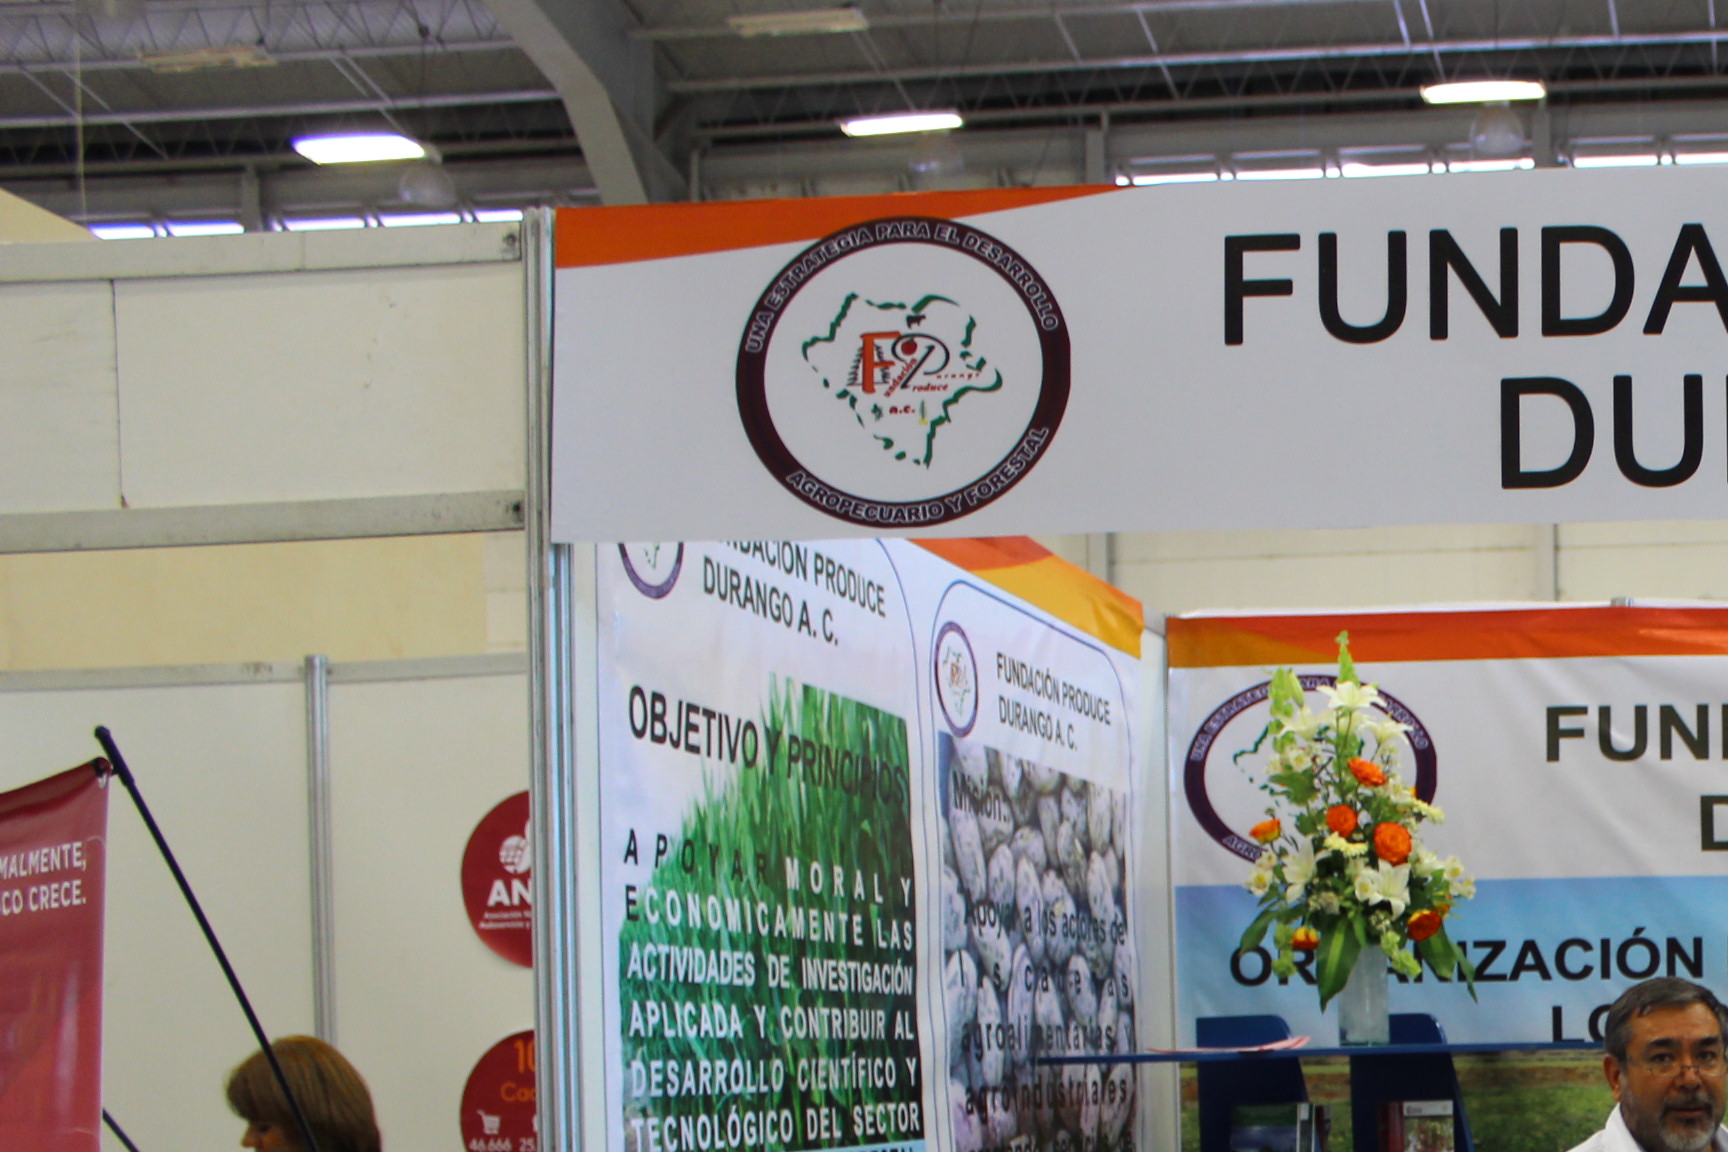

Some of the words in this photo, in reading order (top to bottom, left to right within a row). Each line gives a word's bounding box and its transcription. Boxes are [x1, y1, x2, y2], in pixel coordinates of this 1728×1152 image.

[746, 314, 772, 353] UNA
[772, 226, 873, 311] ESTRATEGIA
[876, 221, 930, 240] PARA
[935, 224, 960, 244] EL
[963, 232, 1058, 331] DESARROLLO
[787, 471, 944, 523] AGROPECUARIO
[945, 491, 964, 513] Y
[967, 426, 1049, 500] FORESTAL
[703, 555, 794, 628] DURANGO
[798, 601, 818, 639] A.
[821, 609, 838, 647] C.
[814, 551, 887, 618] PRODUCE
[997, 652, 1061, 705] FUNDACIÓN
[1062, 680, 1111, 726] PRODUCE
[999, 695, 1053, 744] DURANGO
[629, 684, 759, 770] OBJETIVO
[764, 726, 783, 776] Y
[787, 734, 909, 806] PRINCIPIOS
[29, 879, 86, 912] CRECE.
[623, 828, 768, 887] APOYAR
[785, 856, 884, 904] MORAL
[900, 876, 912, 908] Y
[625, 884, 864, 946] ECONOMICAMENTE
[876, 918, 913, 951] LAS
[1024, 906, 1032, 933] a
[1062, 911, 1106, 945] actores
[627, 941, 756, 989] ACTIVIDADES
[767, 954, 791, 990] DE
[801, 956, 914, 996] INVESTIGACIÓN
[628, 1000, 743, 1039] APLICADA
[753, 1005, 767, 1038] Y
[780, 1005, 886, 1040] CONTRIBUIR
[894, 1010, 914, 1040] AL
[631, 1057, 785, 1098] DESARROLLO
[797, 1052, 897, 1093] CIENTÍFICO
[906, 1057, 919, 1088] Y
[806, 1107, 842, 1142] DEL
[853, 1101, 921, 1135] SECTOR
